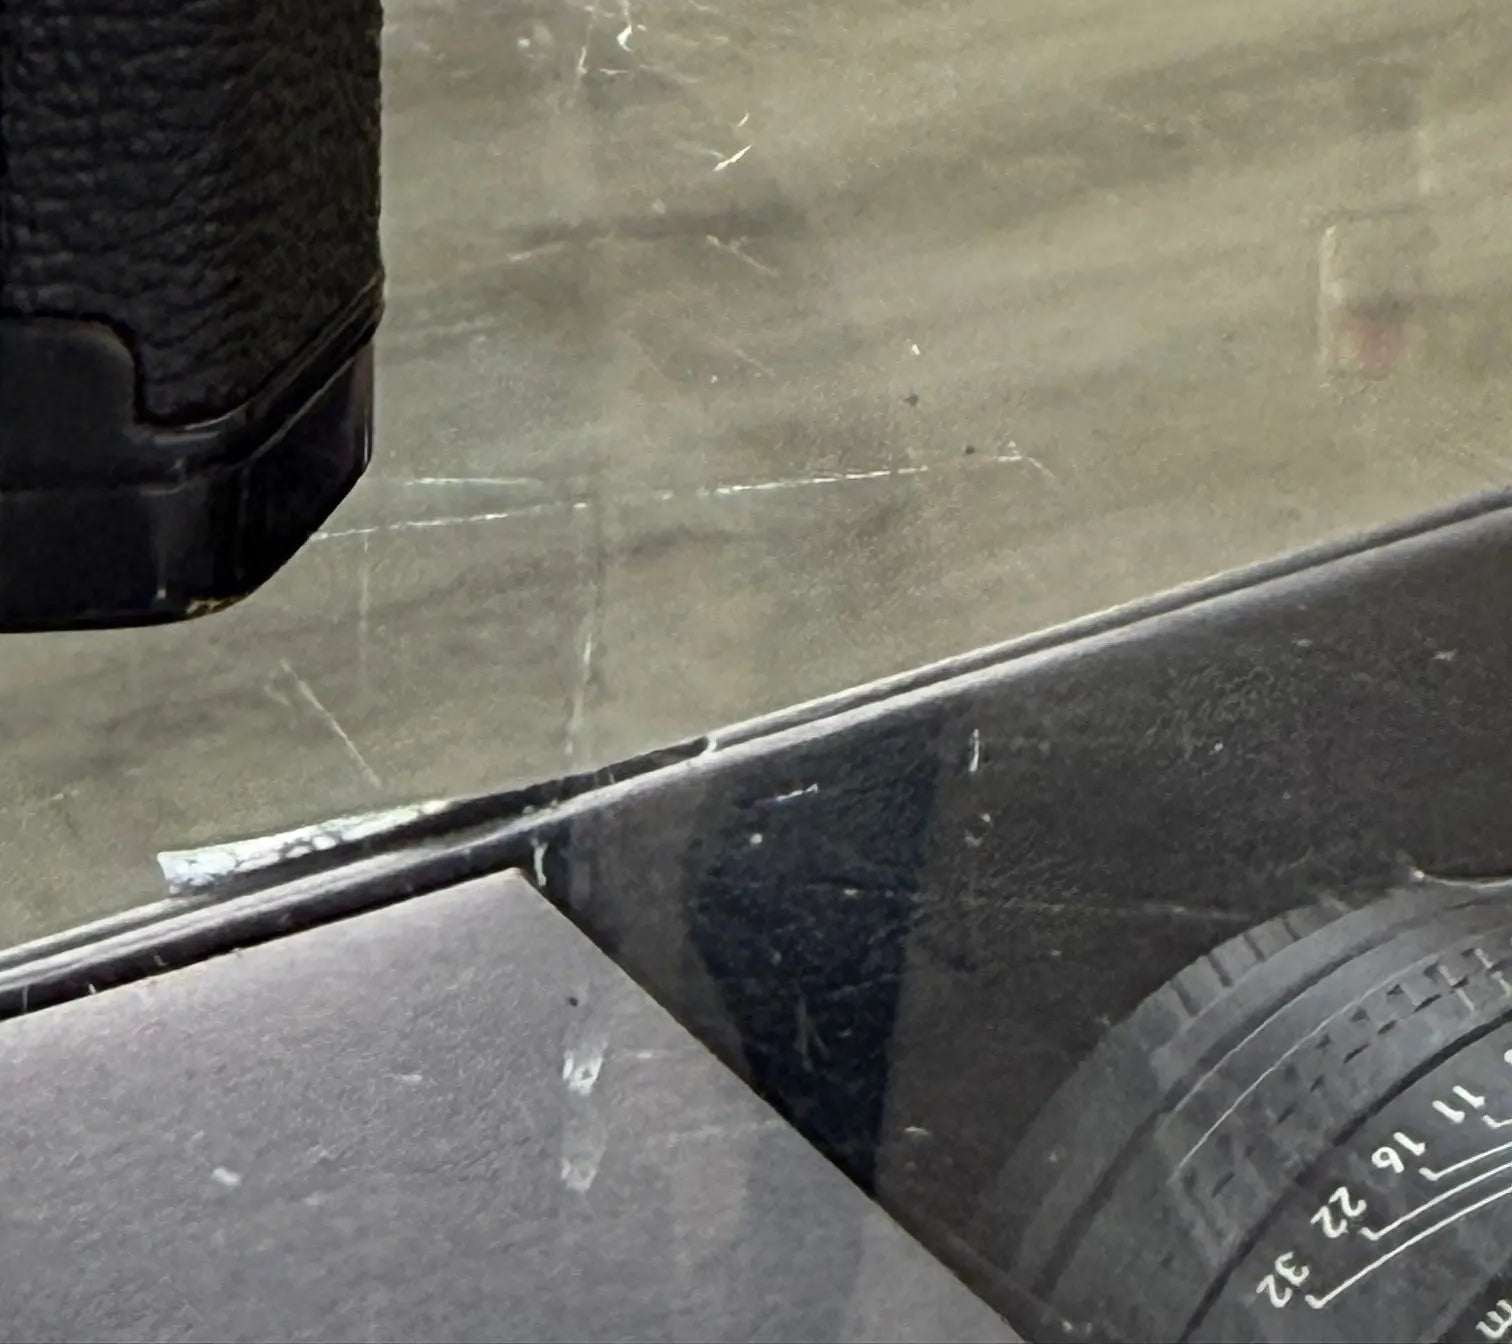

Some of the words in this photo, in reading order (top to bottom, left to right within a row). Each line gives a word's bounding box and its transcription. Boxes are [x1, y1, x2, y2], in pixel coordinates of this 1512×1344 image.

[1431, 1084, 1486, 1124] 11
[1370, 1131, 1427, 1174] 16
[1309, 1185, 1368, 1240] 22
[1255, 1251, 1311, 1309] 32
